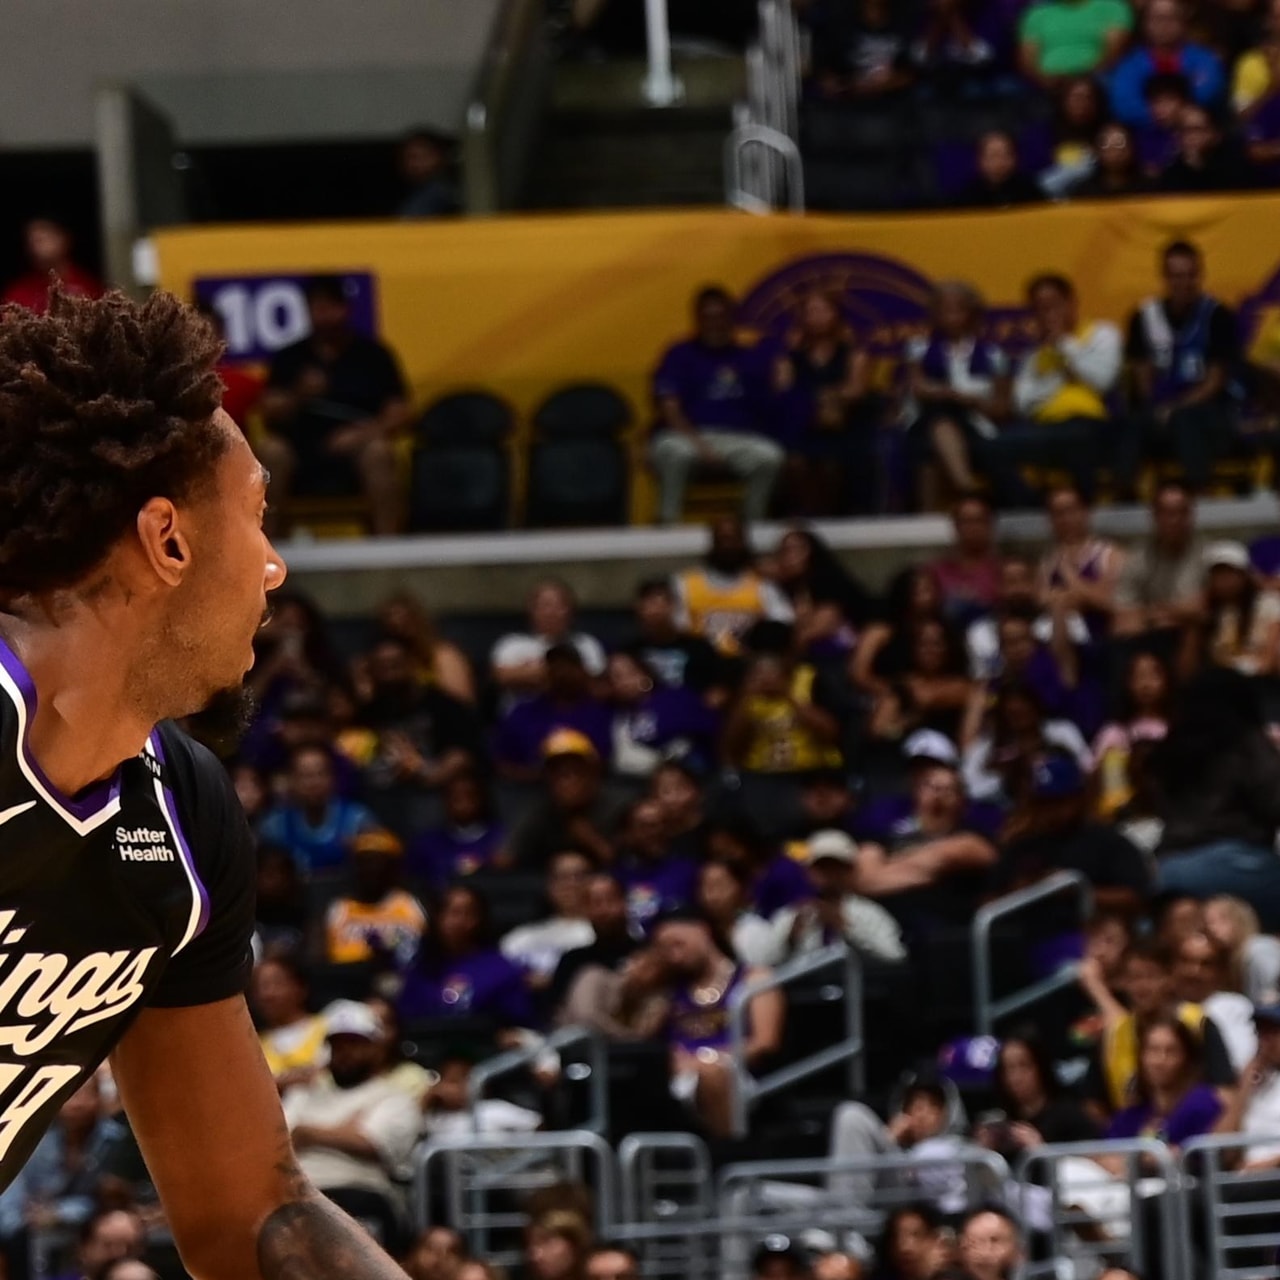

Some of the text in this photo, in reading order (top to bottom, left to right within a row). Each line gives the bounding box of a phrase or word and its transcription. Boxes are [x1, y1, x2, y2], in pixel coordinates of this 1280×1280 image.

[213, 280, 312, 354] 10
[115, 826, 166, 843] Sutter
[119, 845, 175, 862] Health
[0, 909, 160, 1056] ings
